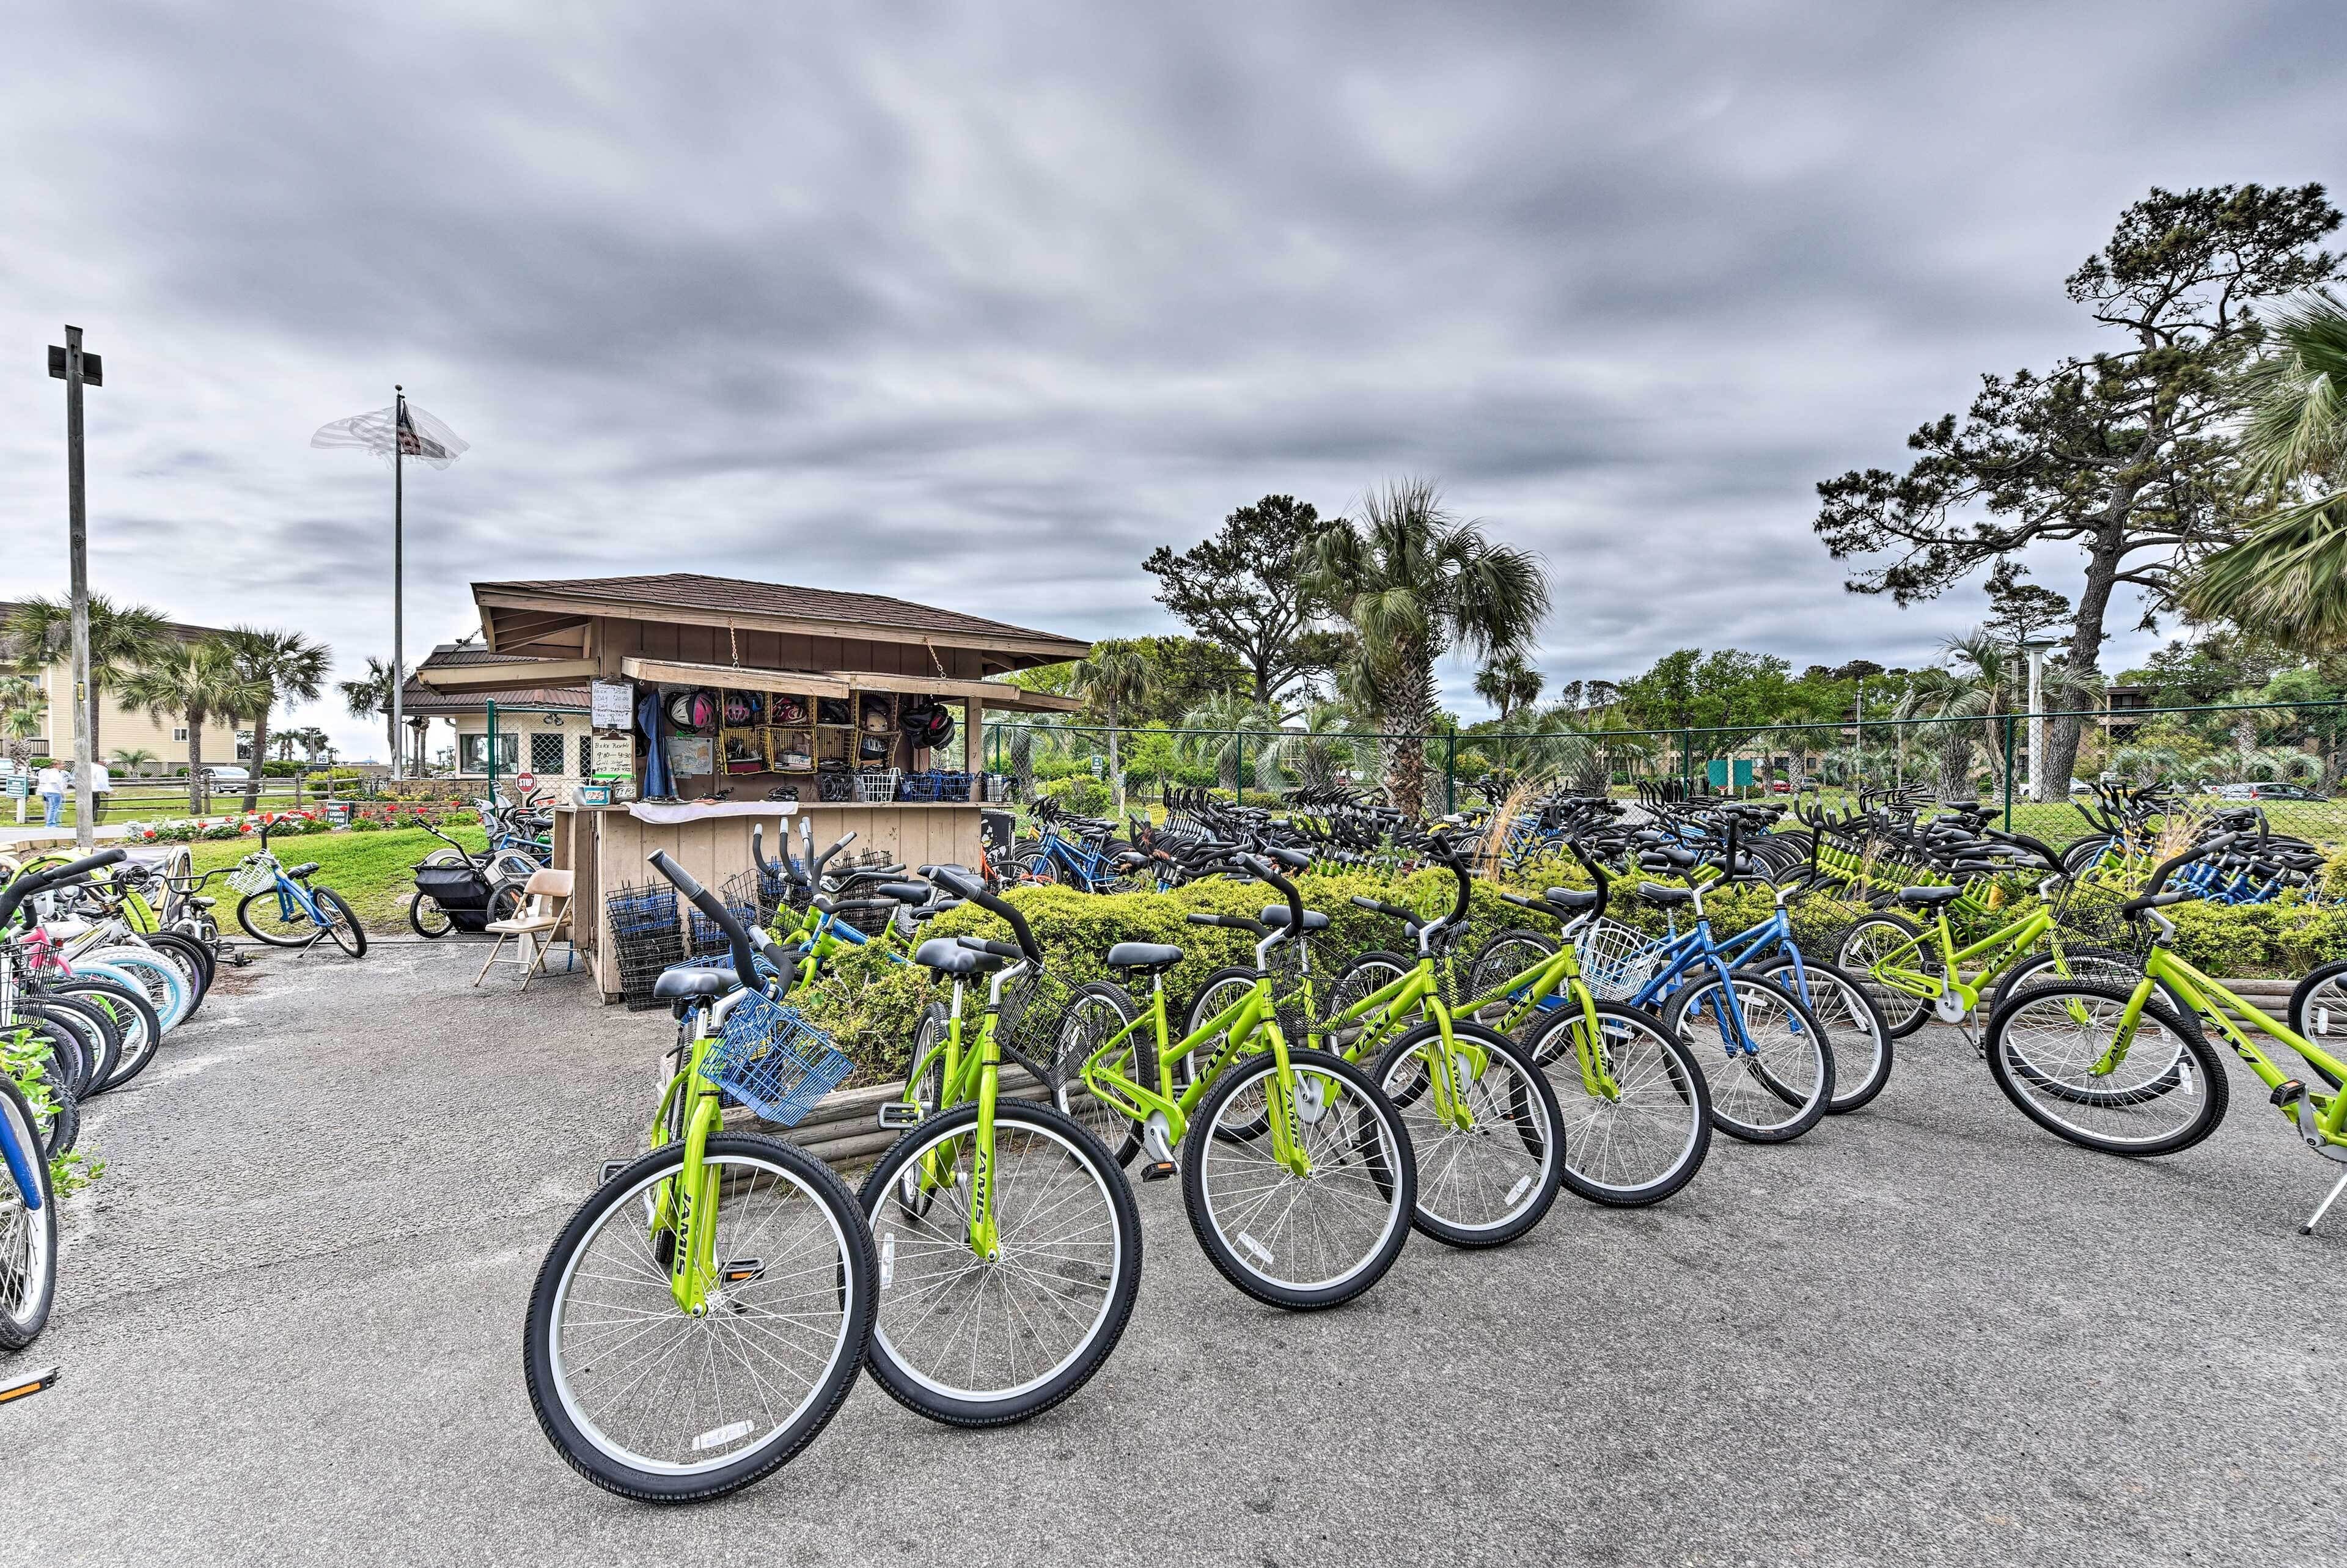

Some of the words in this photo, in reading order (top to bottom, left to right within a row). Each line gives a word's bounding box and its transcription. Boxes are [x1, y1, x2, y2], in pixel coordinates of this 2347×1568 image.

[518, 778, 533, 787] STOP
[1987, 942, 2017, 974] TAXI
[1353, 1009, 1390, 1055] TAXI
[1498, 989, 1535, 1031] TAXI
[2197, 1006, 2261, 1063] TAXI
[1197, 1034, 1231, 1085] TAXI
[2109, 1024, 2128, 1066] JAMIS
[1449, 1049, 1464, 1105] JAMIS
[1284, 1083, 1300, 1149] JAMIS
[975, 1141, 987, 1225] JAMIS
[676, 1184, 692, 1277] JAMIS
